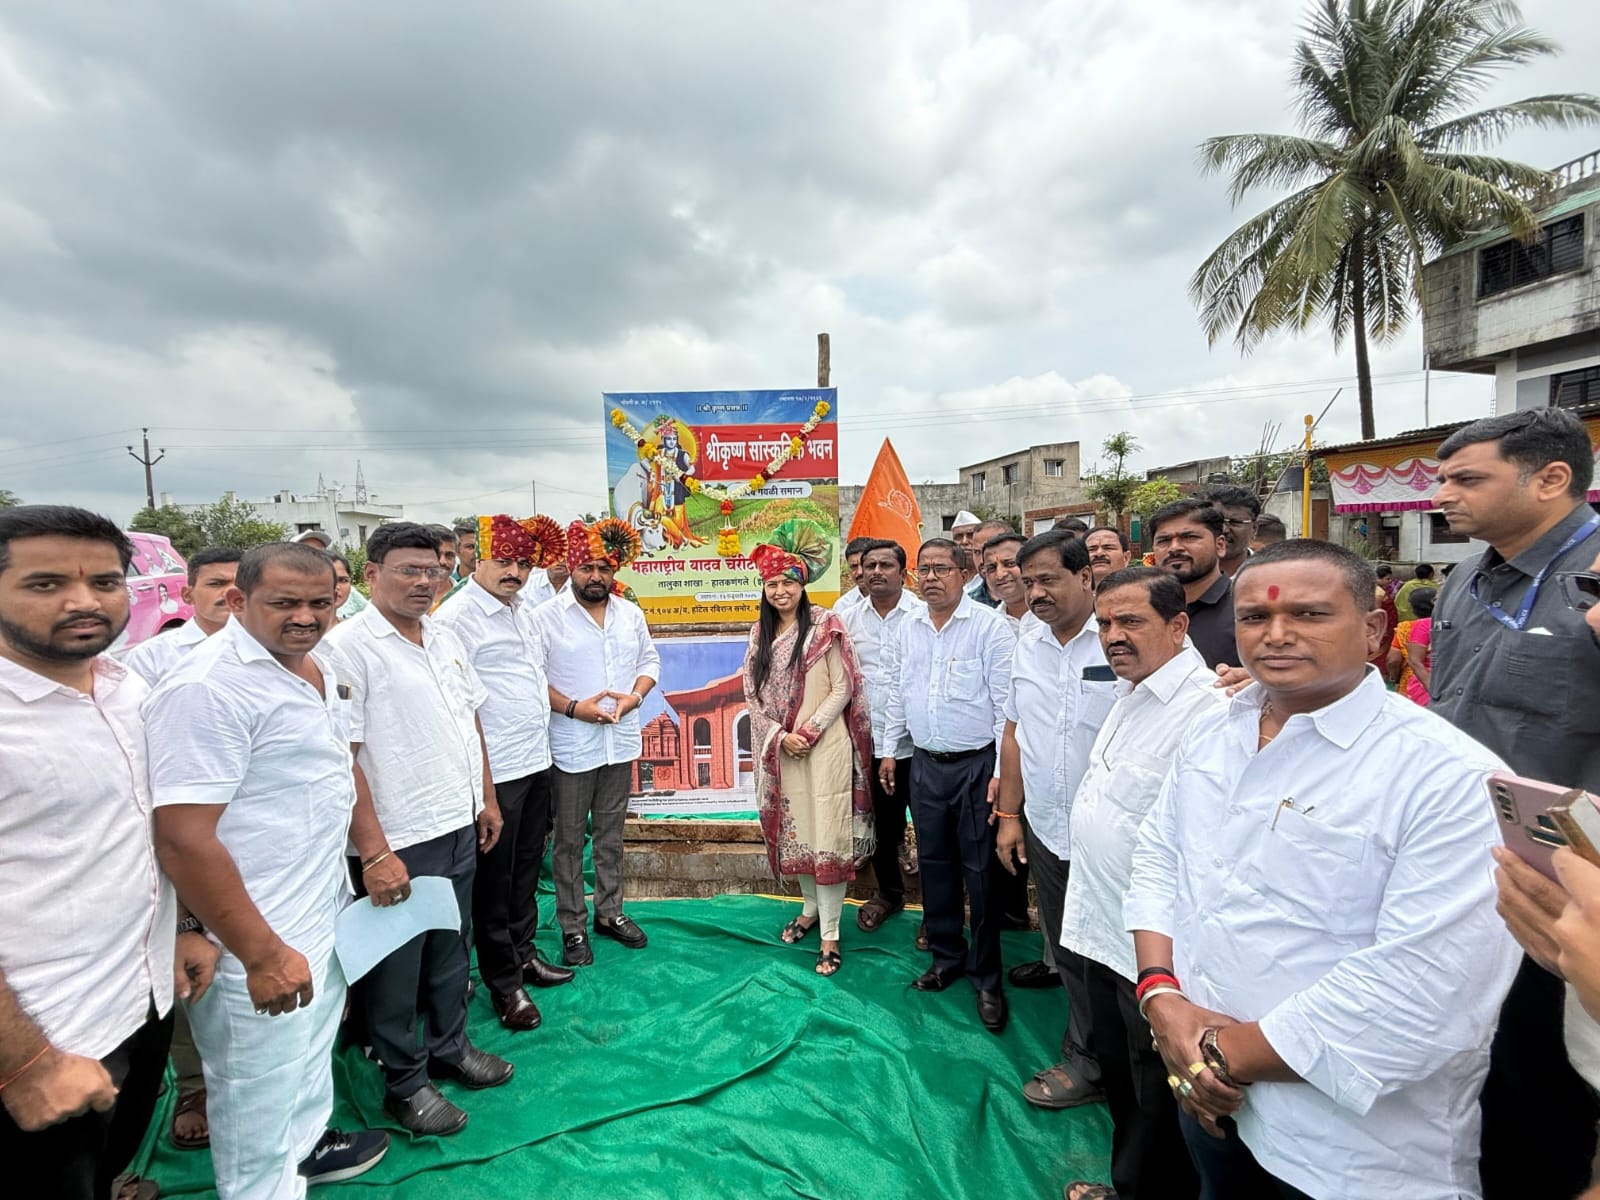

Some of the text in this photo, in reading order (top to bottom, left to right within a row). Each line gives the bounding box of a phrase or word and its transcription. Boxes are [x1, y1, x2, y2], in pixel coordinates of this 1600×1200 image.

[706, 433, 746, 470] श्रीकृष्ण
[806, 439, 833, 459] भवन
[631, 555, 686, 576] महाराष्ट्रीय
[689, 559, 721, 571] यादव
[658, 580, 682, 590] तालुका
[684, 579, 703, 588] शाखा
